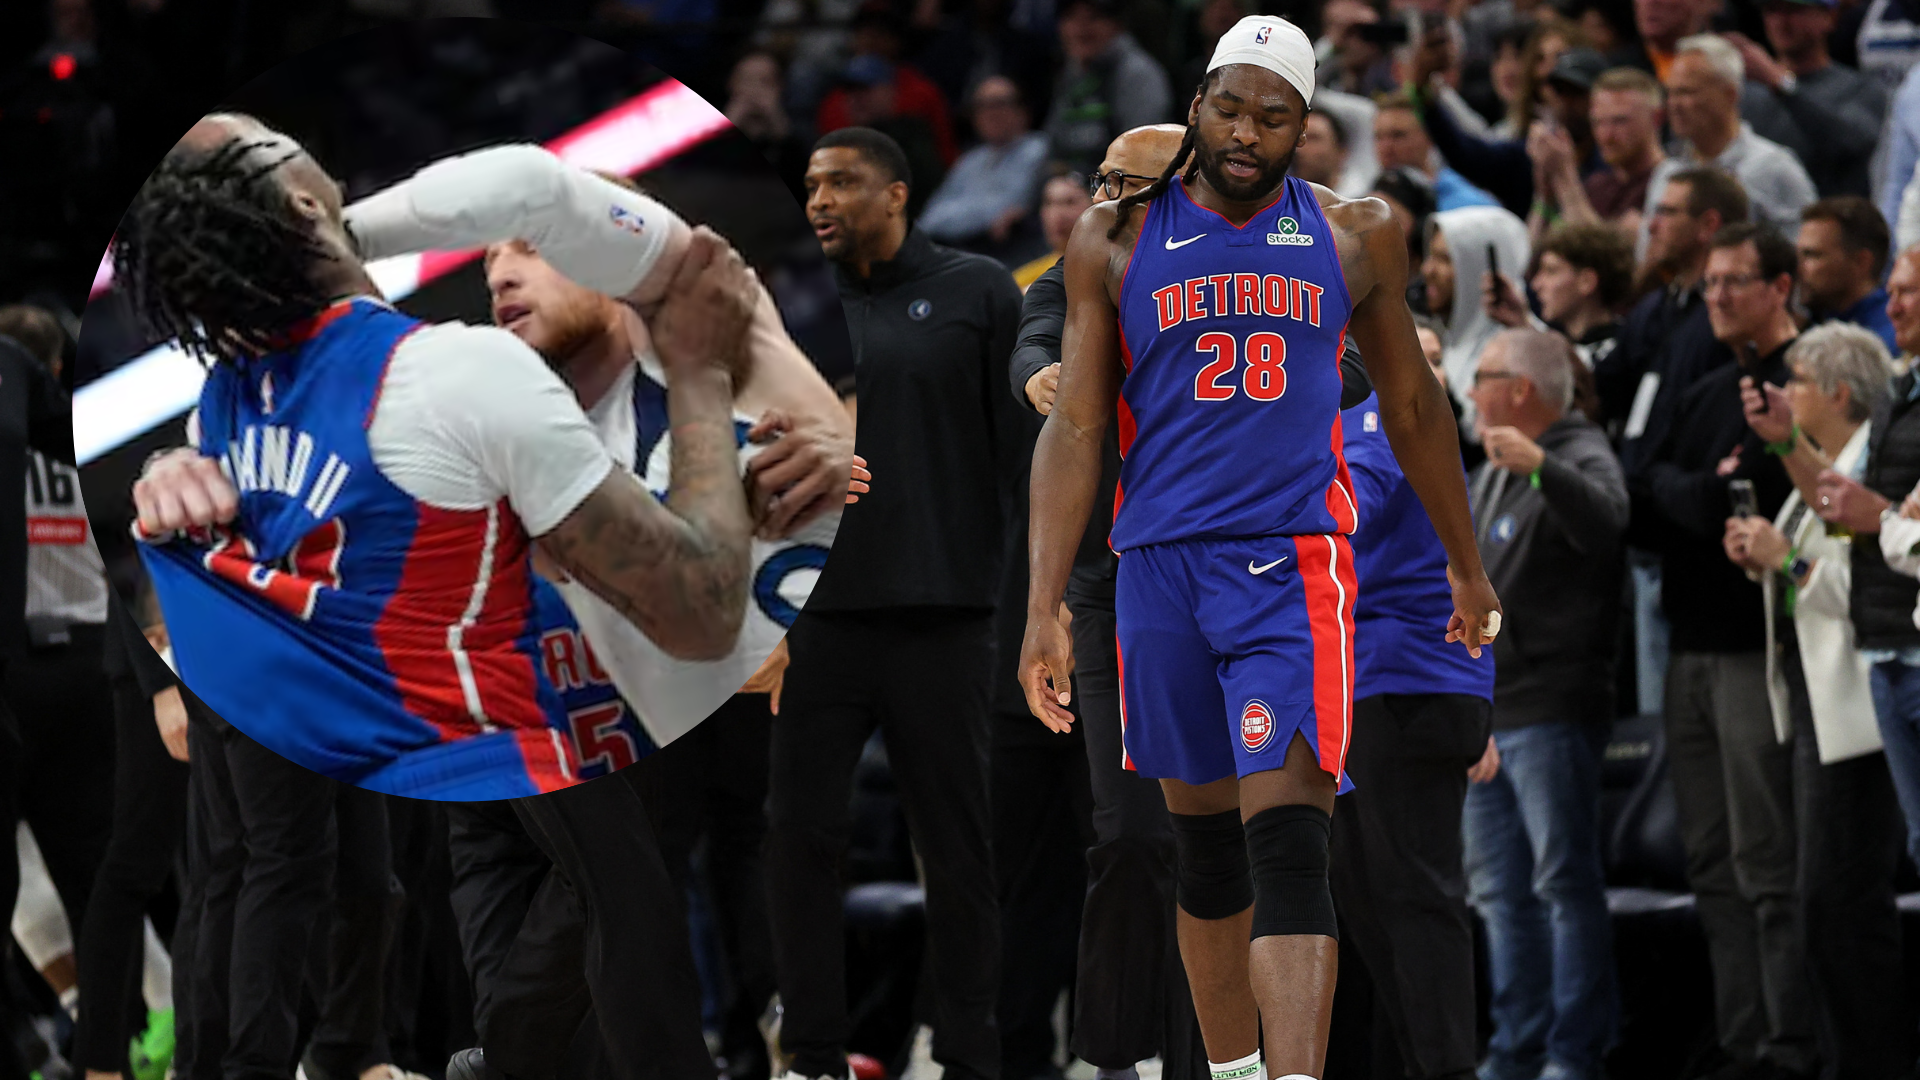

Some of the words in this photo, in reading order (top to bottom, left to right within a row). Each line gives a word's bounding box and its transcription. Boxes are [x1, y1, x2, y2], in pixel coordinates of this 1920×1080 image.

[1268, 234, 1312, 244] StockX
[1151, 272, 1324, 333] DETROIT
[1194, 331, 1287, 402] 28
[1244, 716, 1266, 727] DETROIT
[1244, 725, 1266, 735] PISTONS
